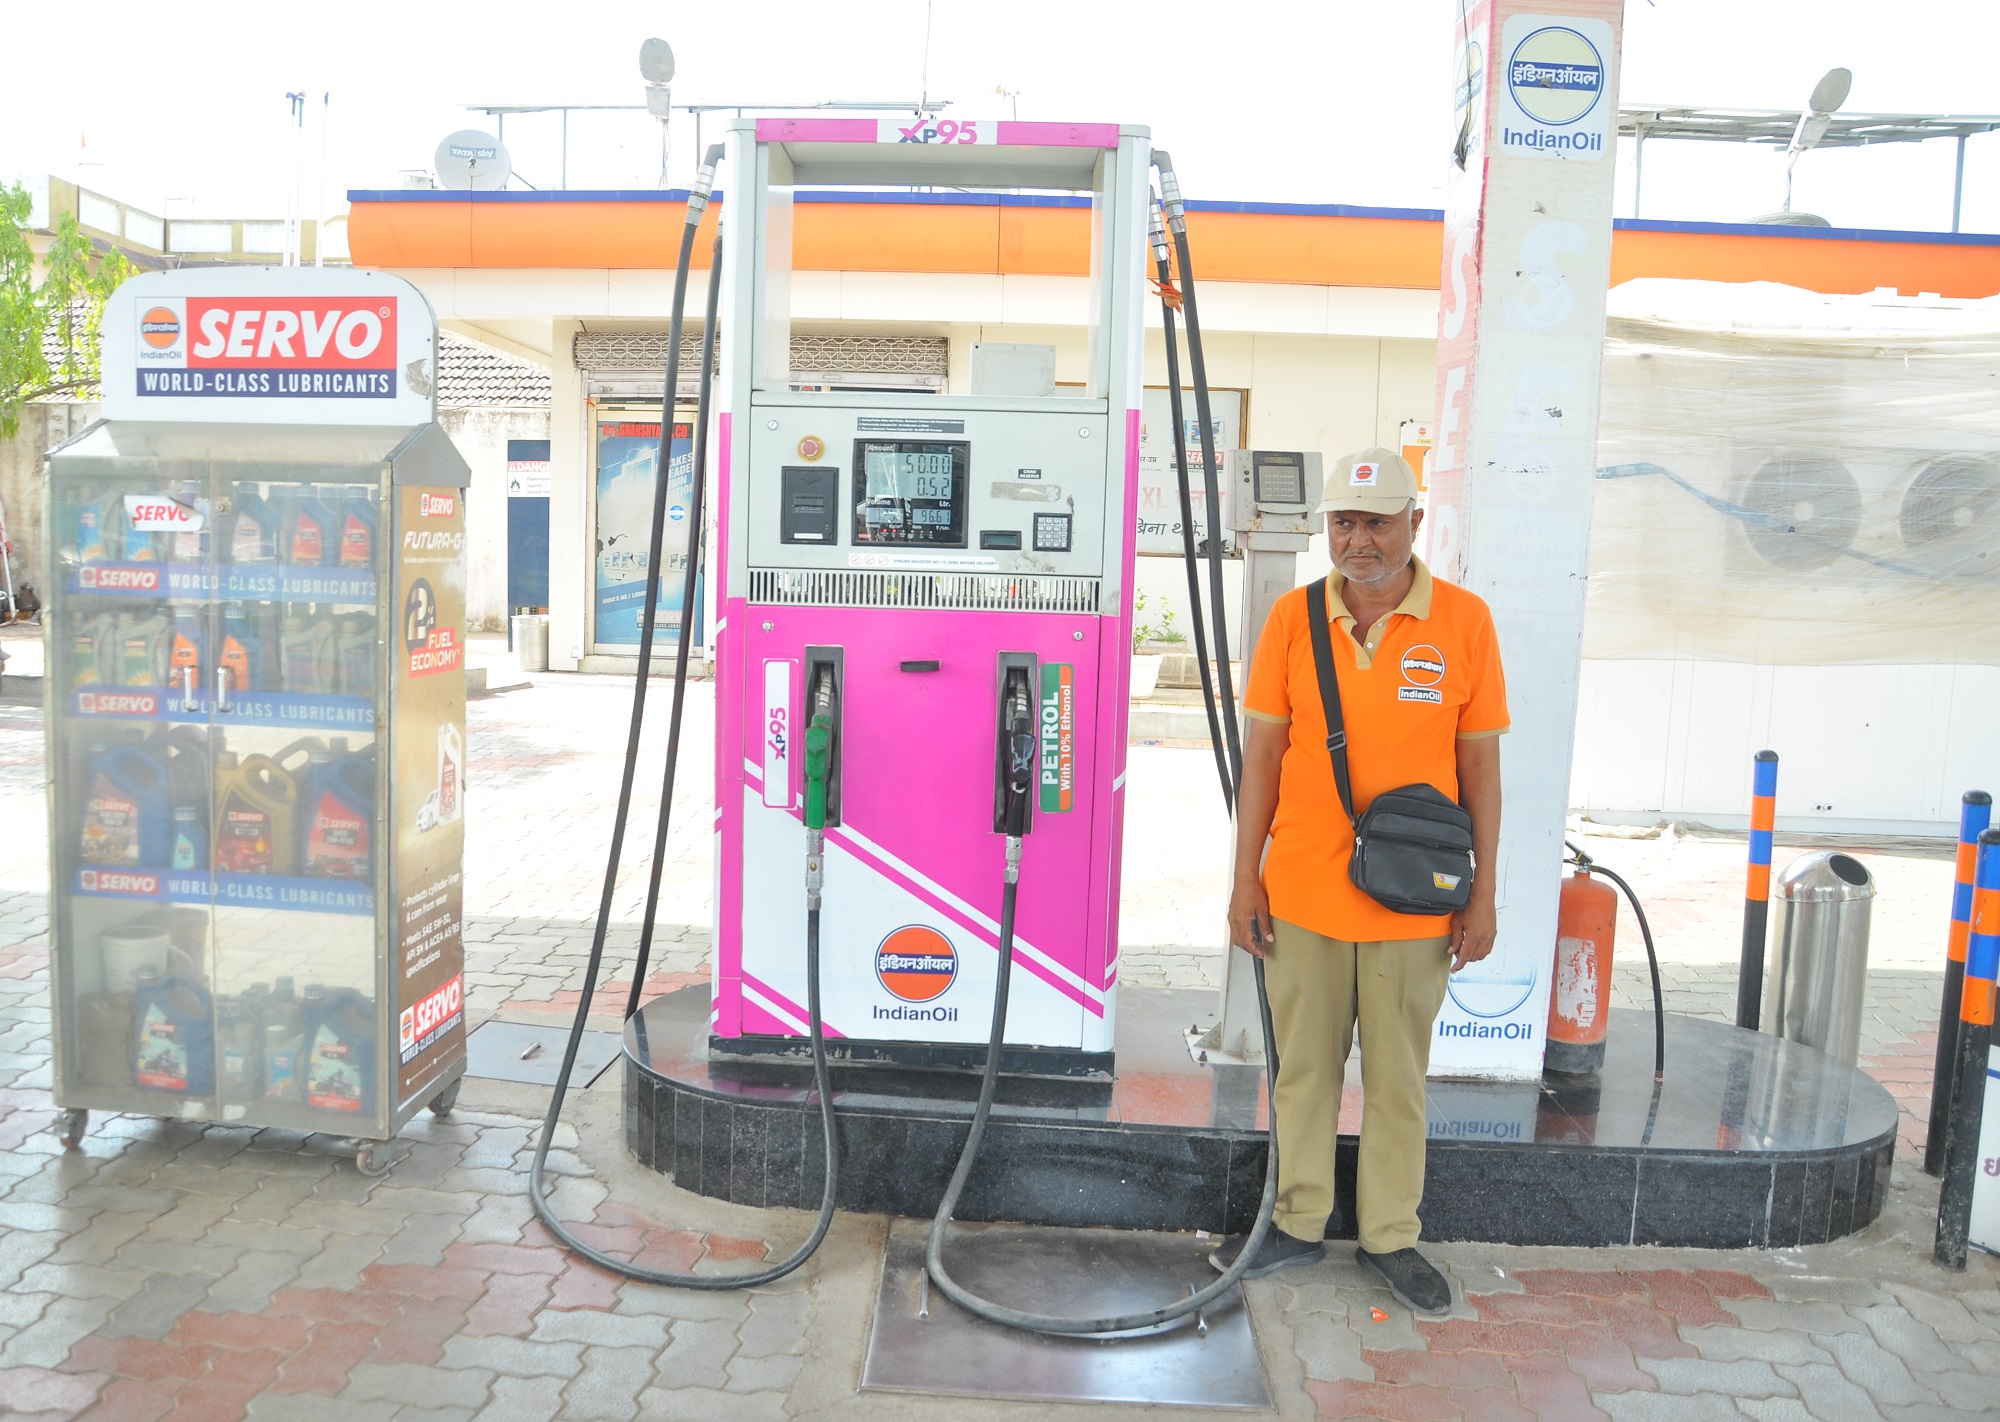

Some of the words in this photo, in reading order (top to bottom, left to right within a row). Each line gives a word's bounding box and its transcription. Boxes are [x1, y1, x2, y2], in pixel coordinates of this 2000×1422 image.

[1513, 63, 1598, 85] इंडियनऑयल
[898, 120, 978, 145] XP95
[1503, 127, 1602, 151] IndianOil
[451, 148, 474, 157] TATA
[140, 351, 182, 359] IndianOil
[144, 372, 270, 393] WORLD-CLASS
[278, 374, 389, 393] LUBRICANTS
[517, 462, 551, 472] DANGE
[670, 452, 693, 468] AKES
[906, 454, 951, 475] 50.00
[1186, 451, 1224, 465] SERO
[917, 477, 950, 497] 0.52
[429, 496, 454, 515] SERVO
[99, 569, 156, 588] SERVO
[169, 573, 276, 592] WORLD-CLASS
[283, 579, 377, 597] LUBRICANTS
[428, 631, 453, 650] FUEL
[1400, 689, 1441, 701] IndianOil
[99, 696, 154, 712] SERVO
[167, 698, 273, 717] WORLDCLASS
[280, 704, 375, 723] LUBRICANTS
[1061, 685, 1071, 731] Ethanol
[768, 707, 786, 761] XP95
[1042, 692, 1059, 785] PETROL
[1061, 733, 1071, 759] 10%
[1061, 763, 1071, 791] With
[238, 813, 263, 821] SERVO
[330, 820, 360, 829] SERVO
[100, 874, 156, 892] SERVO
[281, 888, 374, 909] LUBRICANTS
[406, 889, 428, 908] Protects
[406, 930, 421, 947] Meets
[421, 922, 433, 937] SAE
[406, 949, 441, 979] specifications
[879, 954, 954, 971] इंडियनऑयल
[416, 980, 460, 1036] SERVO
[873, 1005, 958, 1022] IndianOil
[1439, 1020, 1532, 1040] IndianOil
